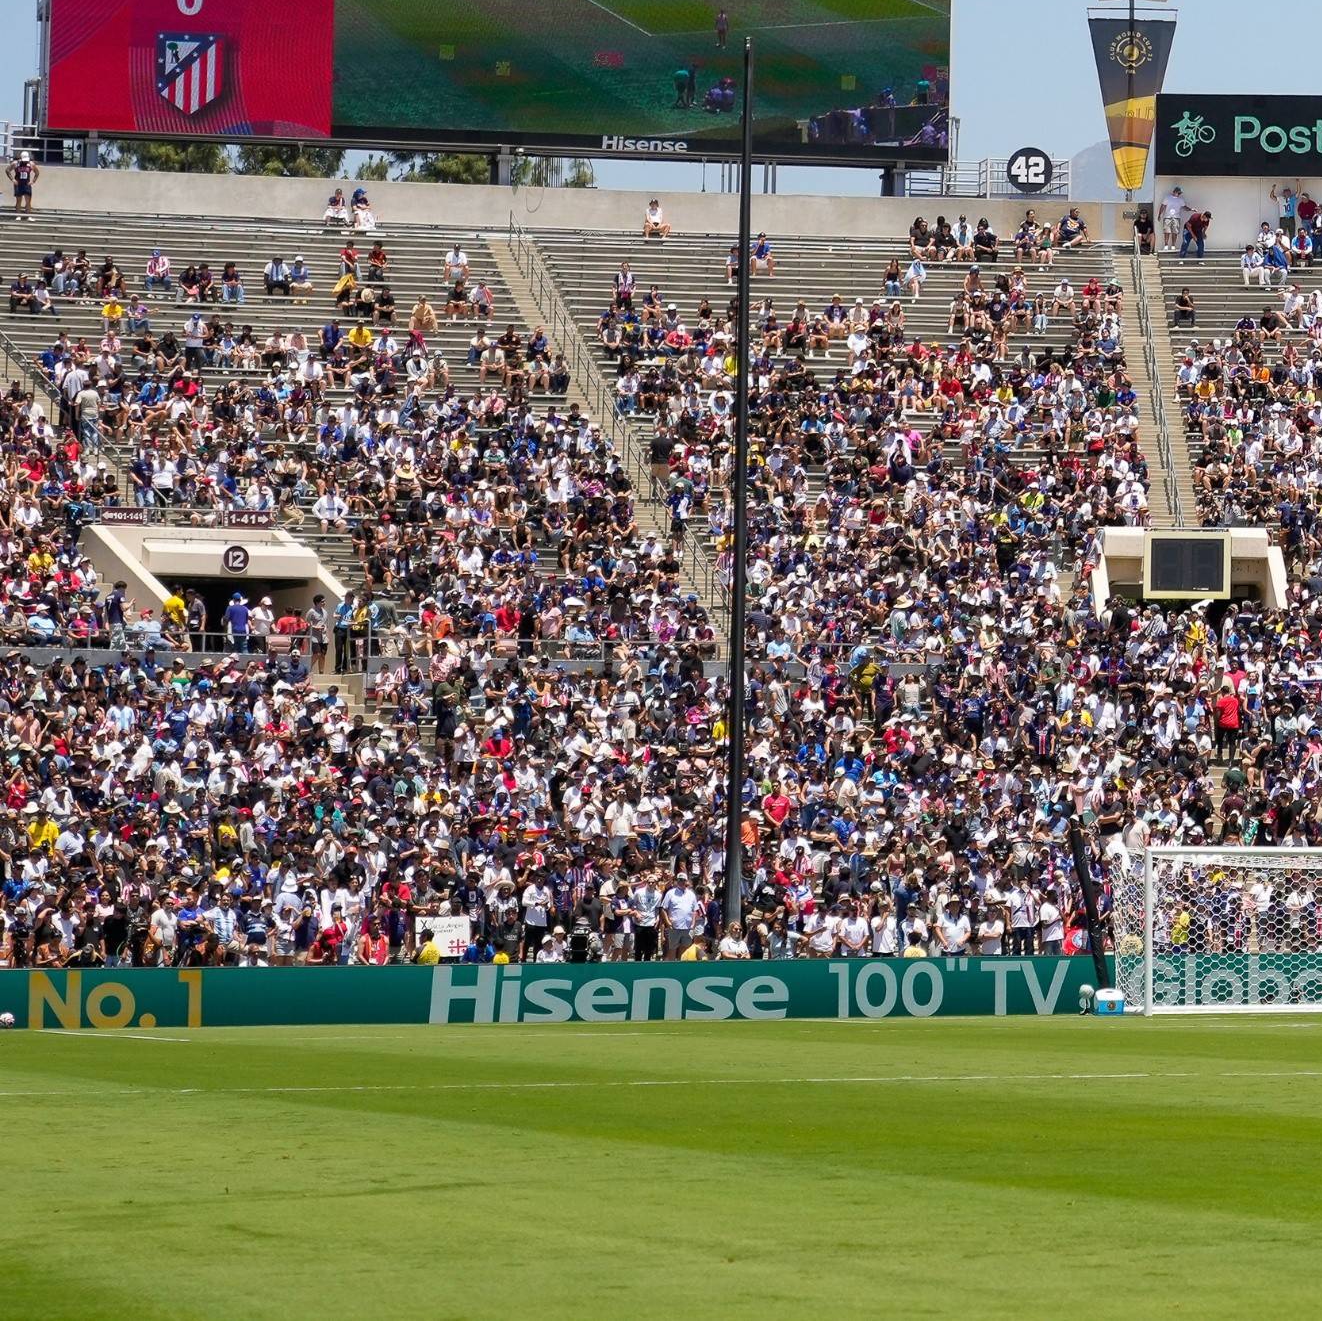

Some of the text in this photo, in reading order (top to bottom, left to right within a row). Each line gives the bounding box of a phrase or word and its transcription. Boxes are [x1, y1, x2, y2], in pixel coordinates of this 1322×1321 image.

[602, 135, 688, 153] Hisense
[1011, 155, 1045, 184] 42
[230, 514, 257, 524] 1-41
[229, 551, 244, 568] 12
[28, 968, 202, 1028] No. 1
[428, 964, 789, 1024] Hisense
[828, 959, 969, 1019] 100"
